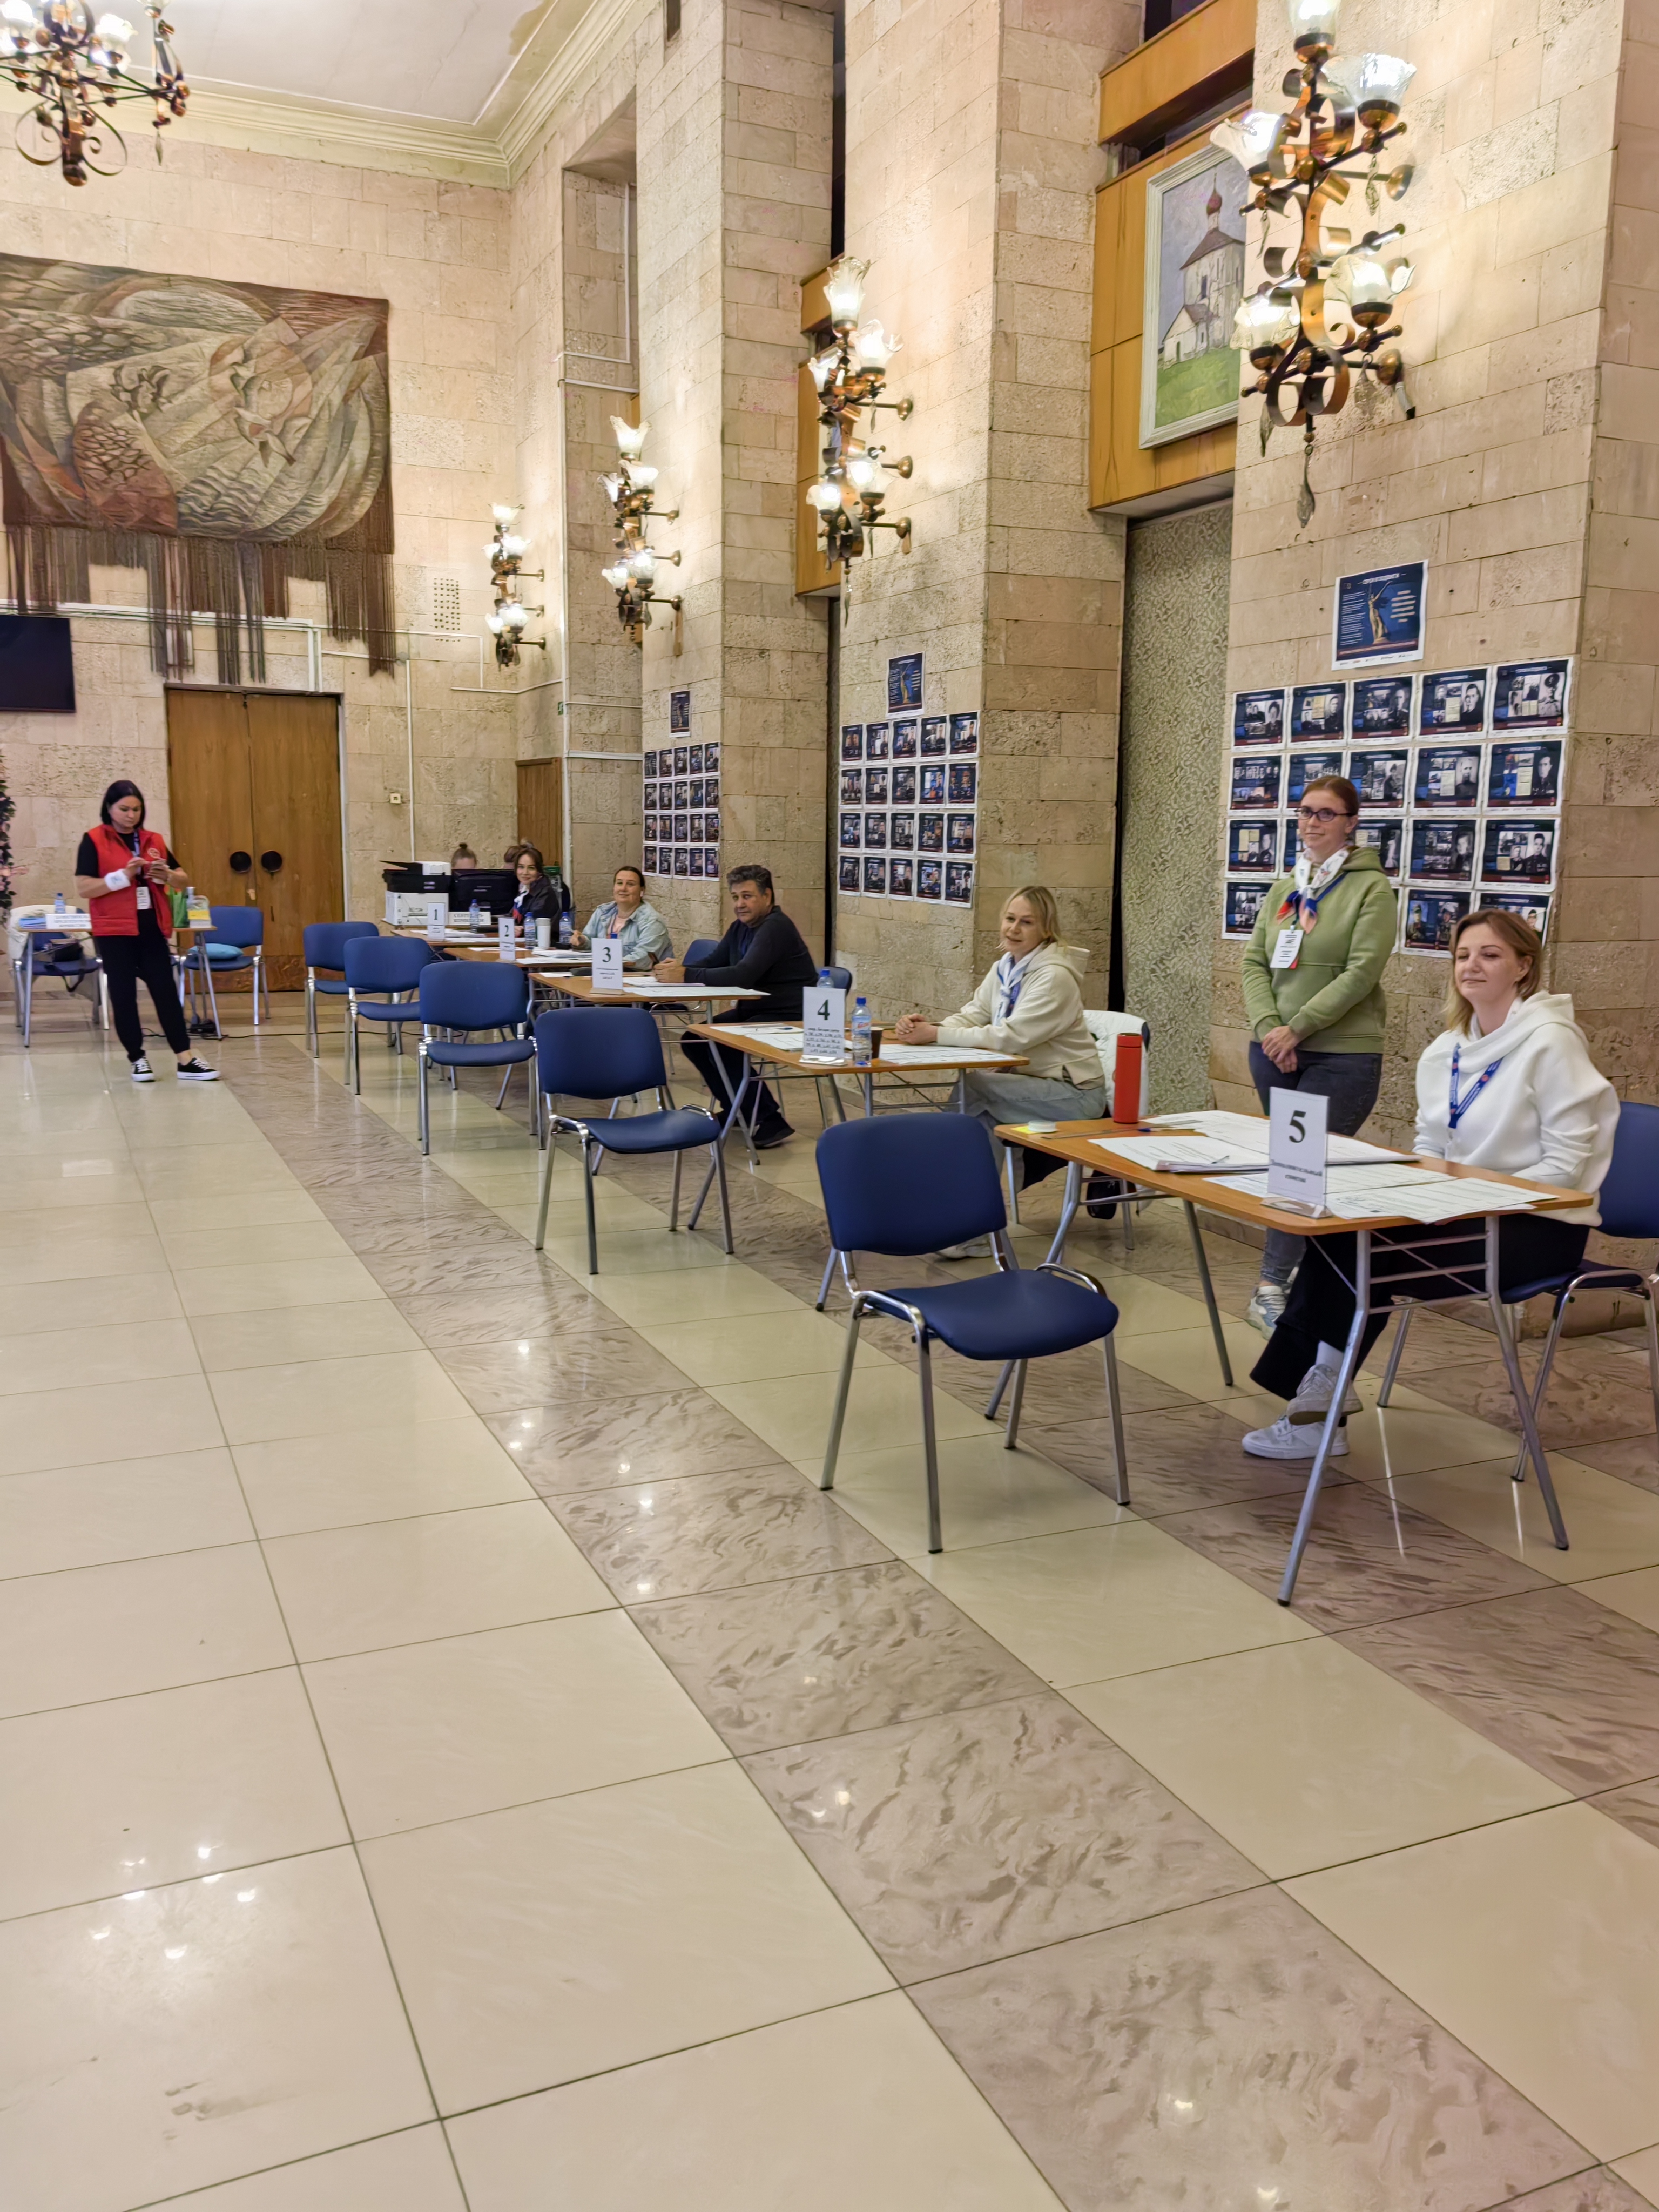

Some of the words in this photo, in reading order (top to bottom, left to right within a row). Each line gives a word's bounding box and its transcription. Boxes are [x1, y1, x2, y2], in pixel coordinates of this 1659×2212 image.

[434, 909, 438, 920] 1
[504, 925, 510, 937] 2
[602, 947, 611, 963] 3
[817, 999, 830, 1020] 4
[1289, 1110, 1306, 1143] 5
